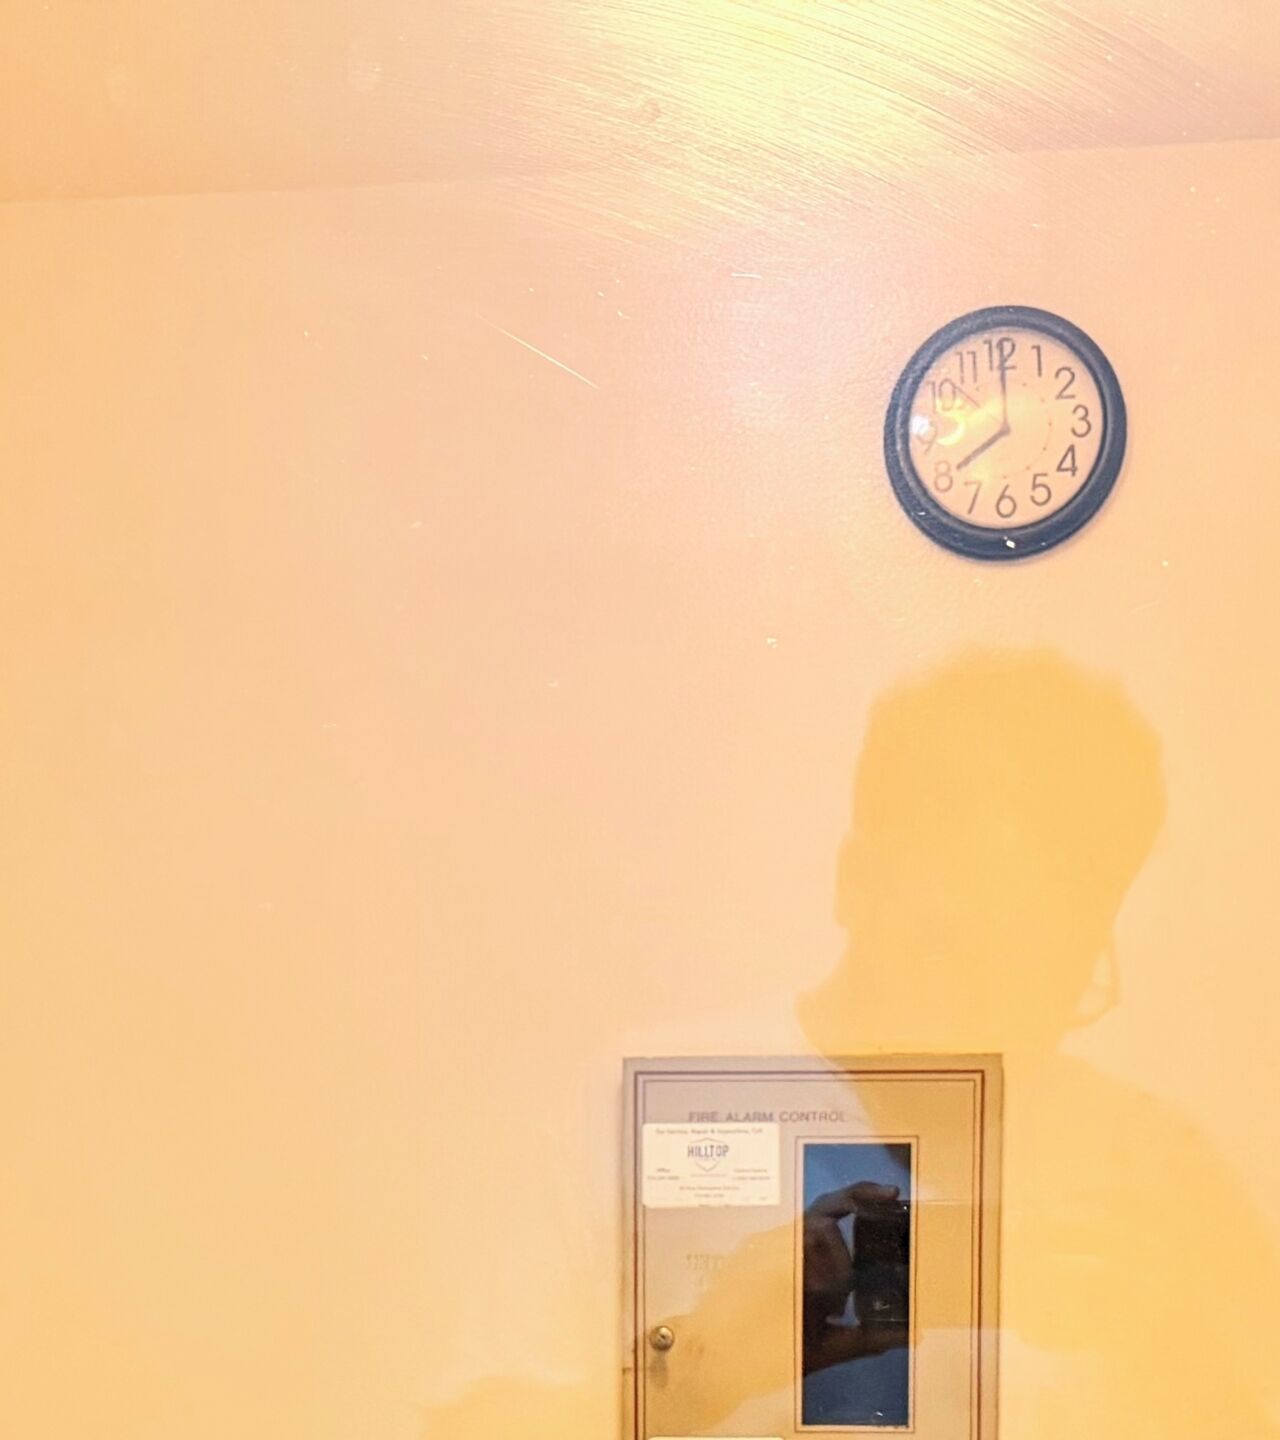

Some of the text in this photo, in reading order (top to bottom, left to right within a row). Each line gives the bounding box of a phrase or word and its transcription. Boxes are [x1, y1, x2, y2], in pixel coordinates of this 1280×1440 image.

[956, 351, 978, 384] 11
[983, 337, 1017, 371] 12
[1031, 344, 1043, 378] 1
[927, 377, 957, 413] 10
[1054, 366, 1076, 400] 2
[1071, 404, 1092, 438] 3
[934, 460, 954, 493] 8
[1055, 443, 1078, 477] 4
[964, 481, 982, 515] 7
[995, 484, 1017, 519] 6
[1030, 473, 1052, 506] 5
[688, 1111, 847, 1123] FIRE ALARM CONTROL
[687, 1144, 730, 1159] HILLTOP
